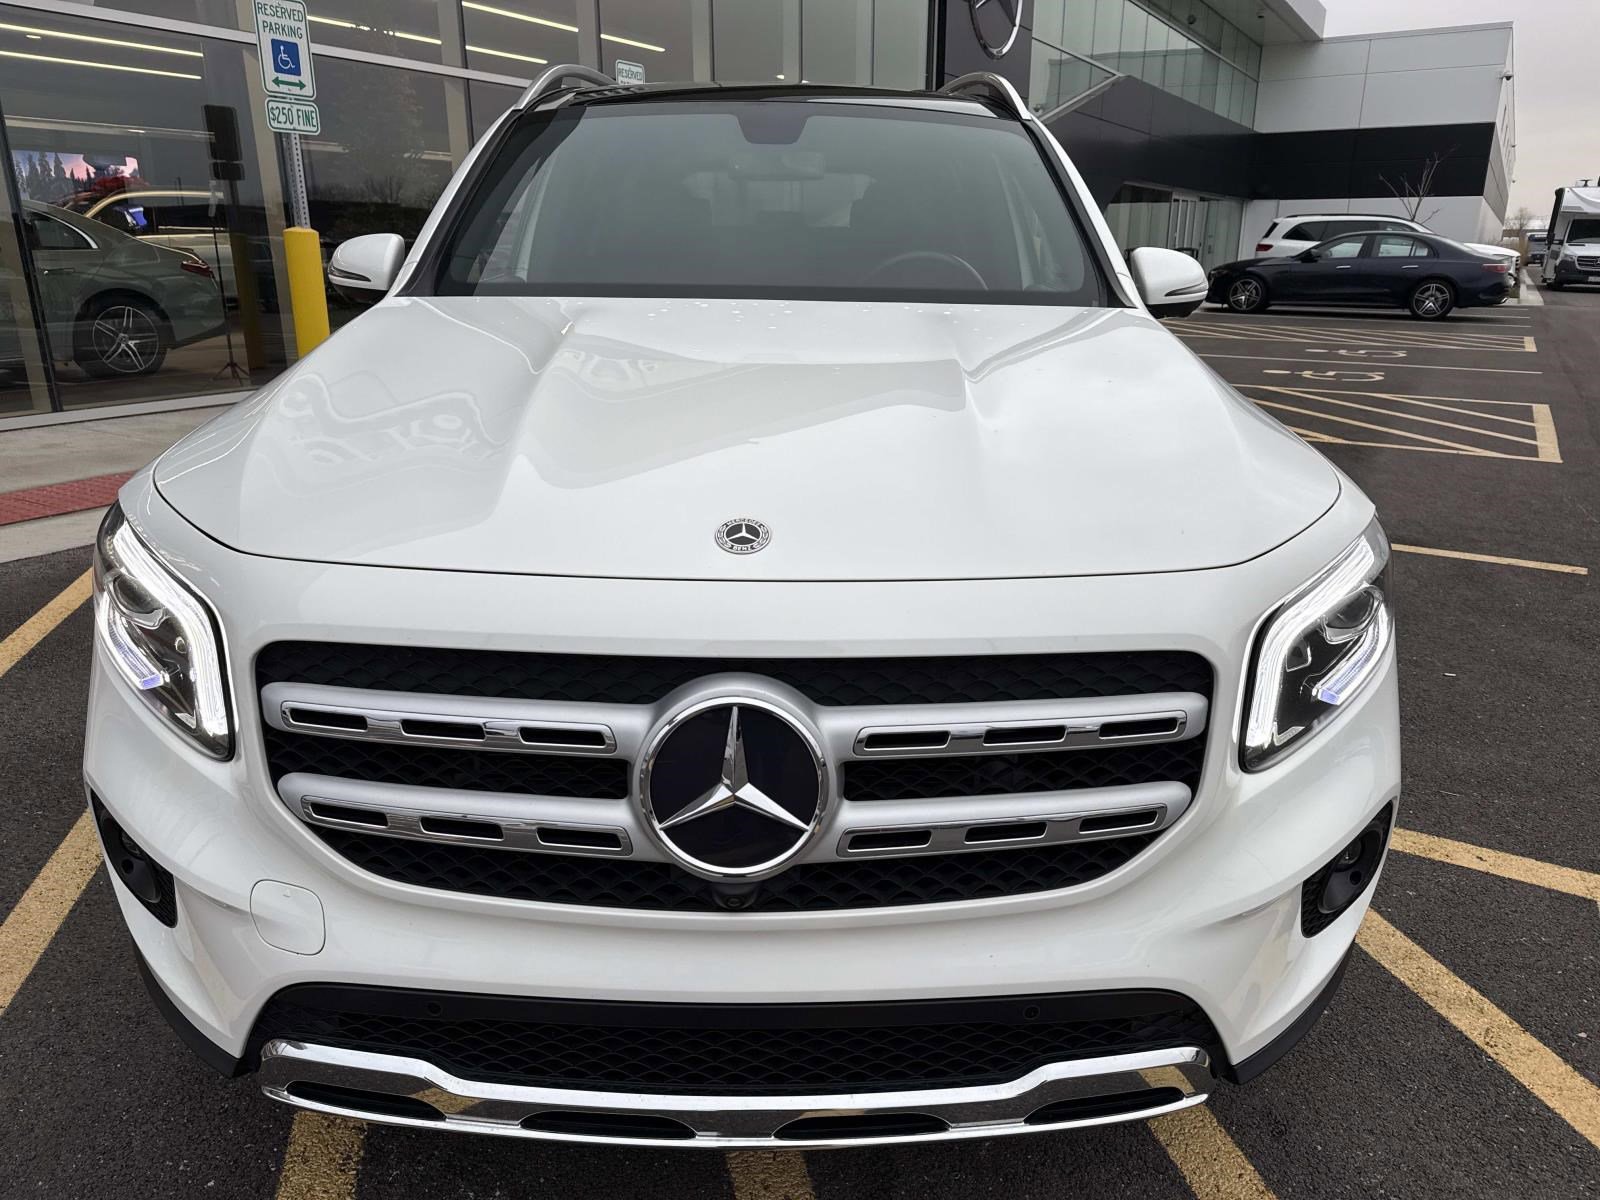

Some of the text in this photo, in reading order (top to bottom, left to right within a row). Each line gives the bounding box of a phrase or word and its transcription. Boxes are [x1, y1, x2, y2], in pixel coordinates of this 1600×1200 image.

[256, 2, 304, 22] RESERVED
[262, 21, 303, 39] PARKING
[269, 106, 317, 127] $250 FINE
